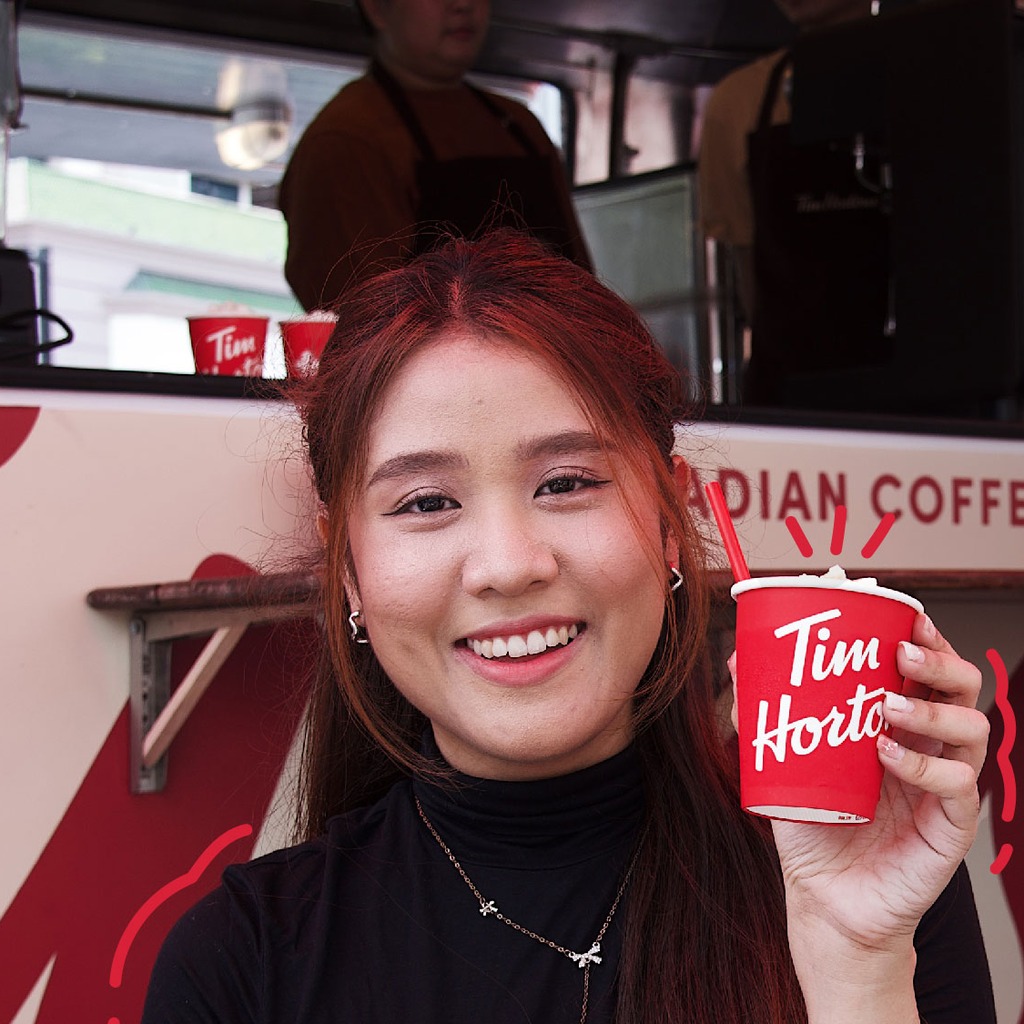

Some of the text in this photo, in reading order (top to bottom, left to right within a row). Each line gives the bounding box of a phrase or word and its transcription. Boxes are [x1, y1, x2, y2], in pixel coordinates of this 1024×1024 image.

[205, 325, 256, 363] Tim
[870, 473, 1024, 527] COFFE
[774, 608, 880, 687] Tim
[752, 684, 890, 772] Horto
